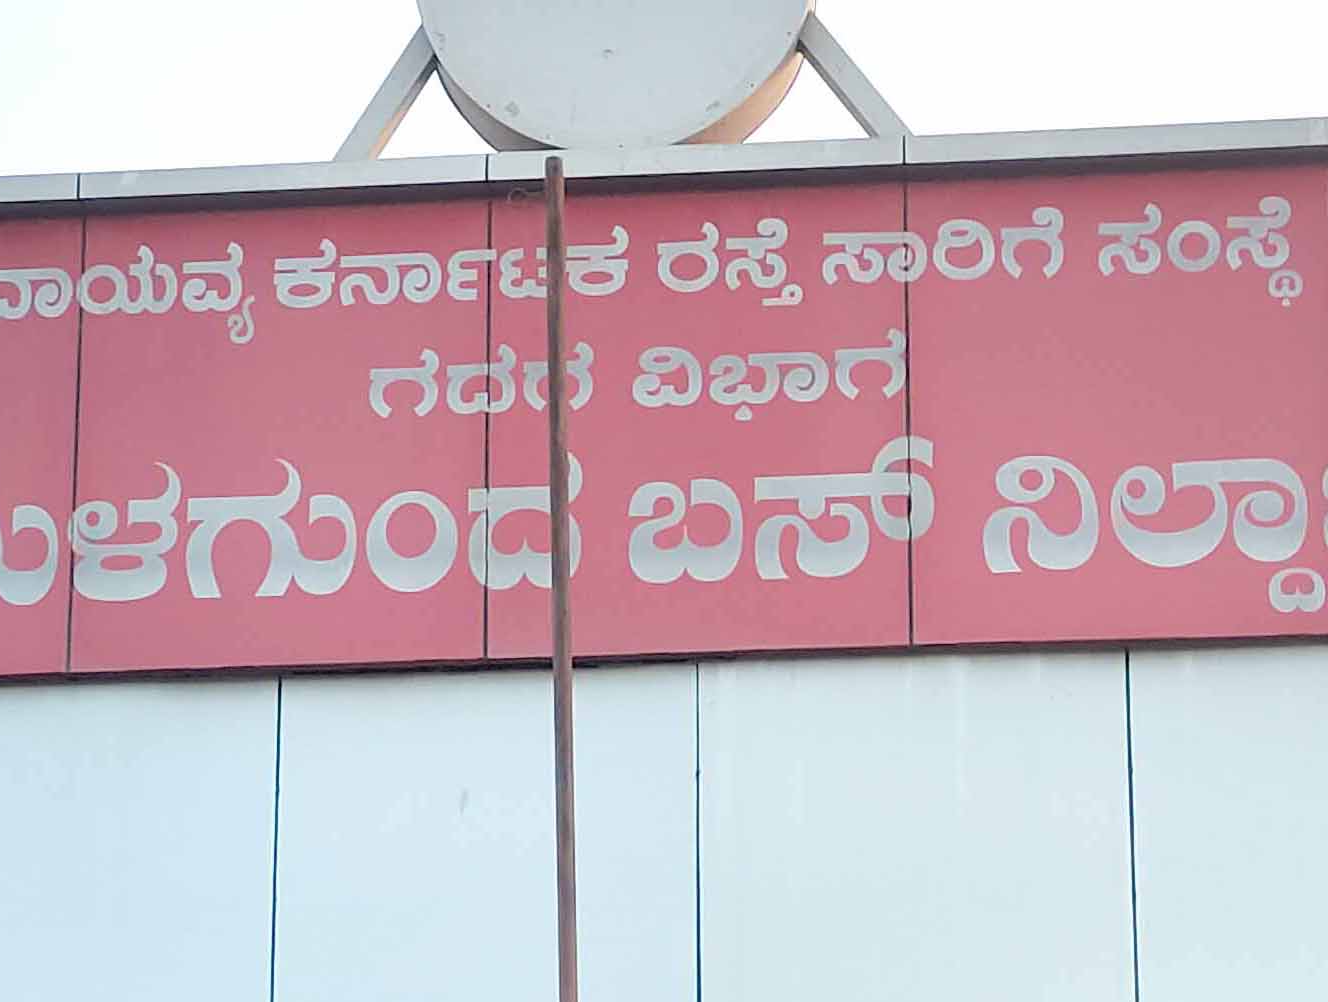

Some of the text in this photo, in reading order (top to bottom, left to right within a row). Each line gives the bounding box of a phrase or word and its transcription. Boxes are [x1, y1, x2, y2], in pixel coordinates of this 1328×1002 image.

[273, 225, 629, 308] ಕರ್ನಾಟಕ
[658, 218, 803, 306] ರಸ್ತೆ
[823, 207, 1064, 284] ಸಾರಿಗೆ
[1098, 196, 1302, 306] ಸಂಸ್ಥೆ
[369, 329, 908, 421] ಗದಗ ವಿಭಾಗ
[624, 435, 934, 584] ಬಸ್
